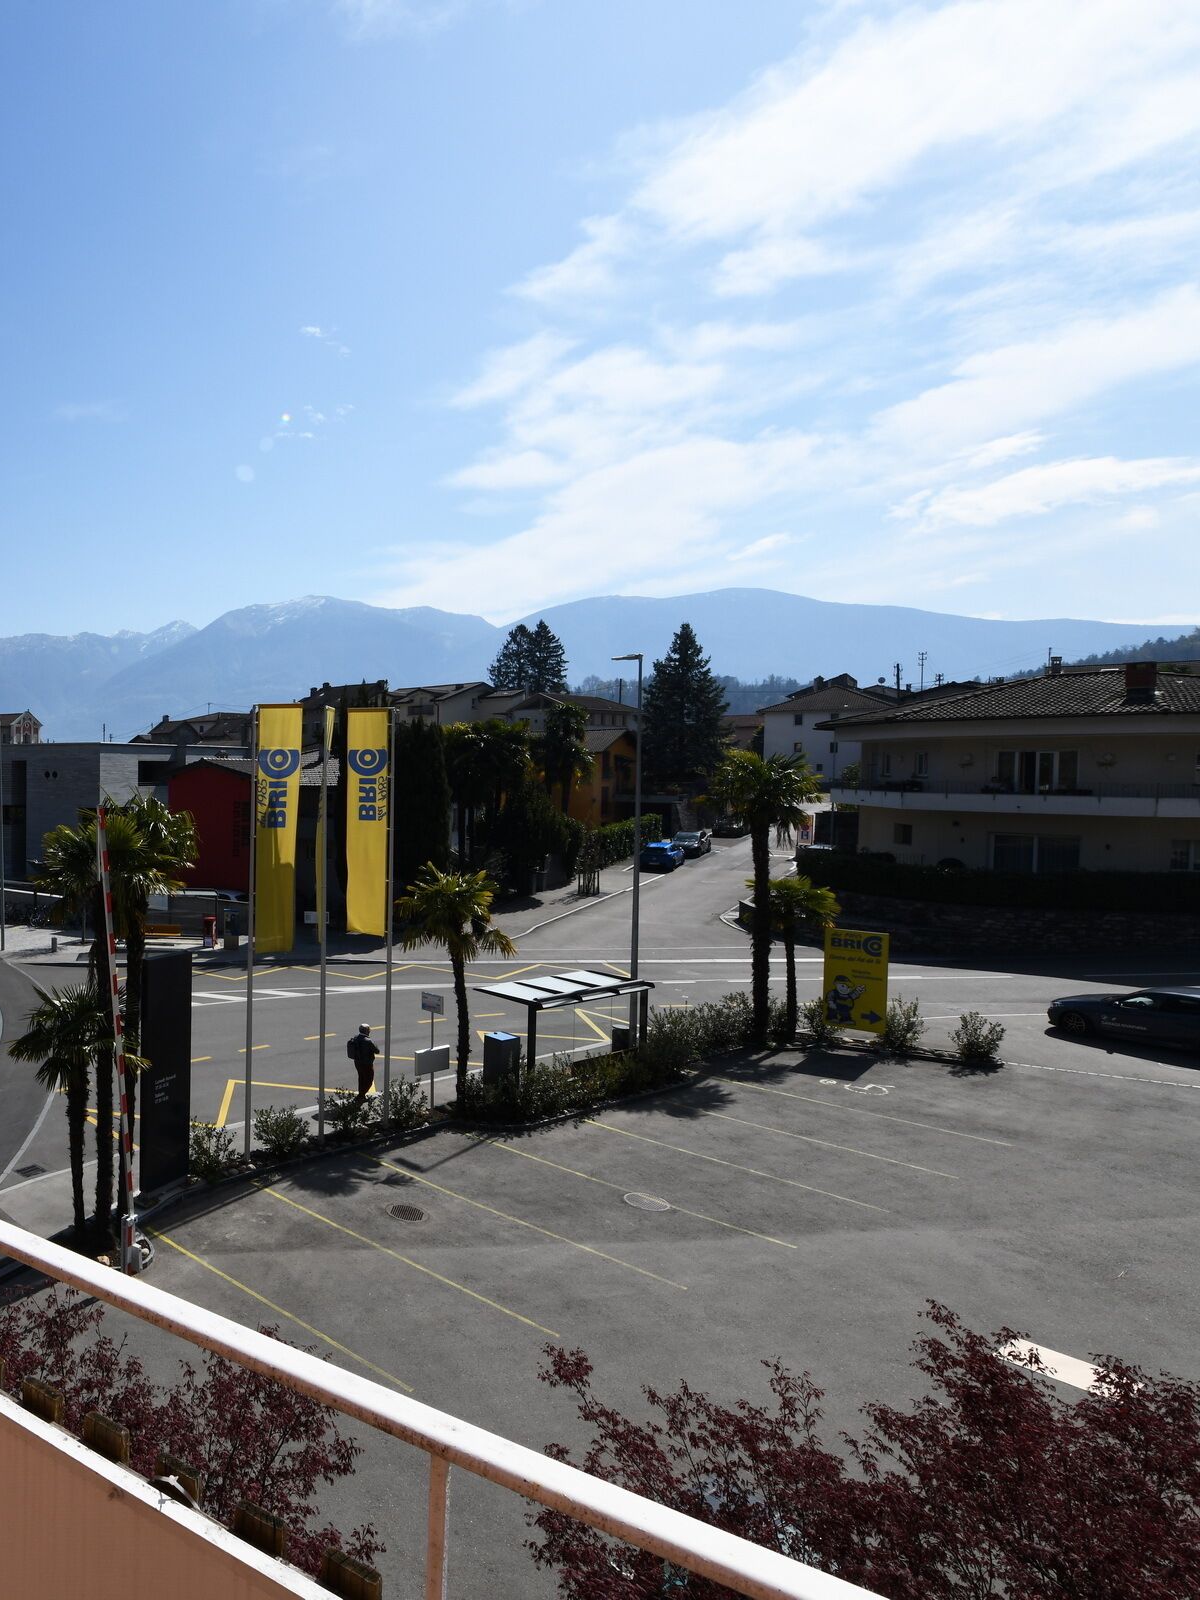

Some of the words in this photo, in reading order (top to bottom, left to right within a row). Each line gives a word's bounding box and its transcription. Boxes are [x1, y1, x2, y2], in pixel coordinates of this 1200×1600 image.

[257, 778, 268, 806] 1985
[258, 749, 300, 829] BRICO
[831, 936, 882, 957] BRICO
